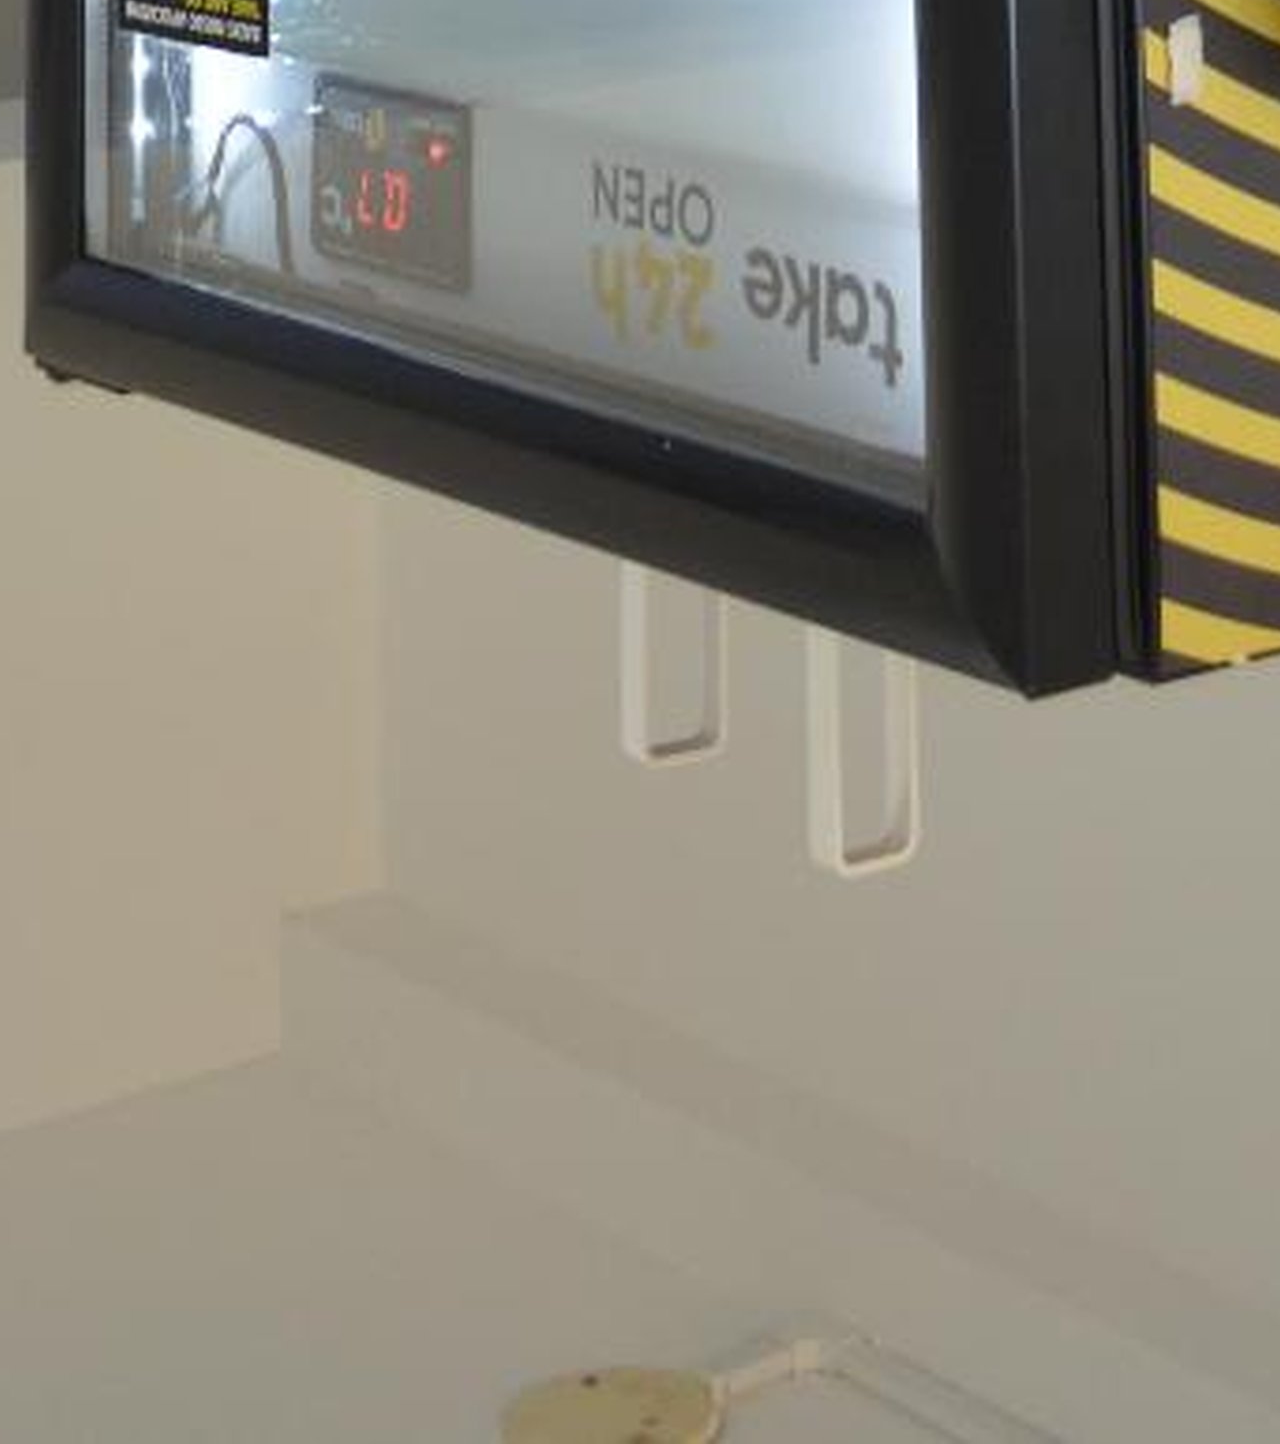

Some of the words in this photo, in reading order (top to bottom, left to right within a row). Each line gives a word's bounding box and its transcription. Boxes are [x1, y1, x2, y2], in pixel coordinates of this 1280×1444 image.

[592, 162, 712, 248] OPEN
[590, 240, 715, 348] 24h
[741, 248, 904, 389] take
